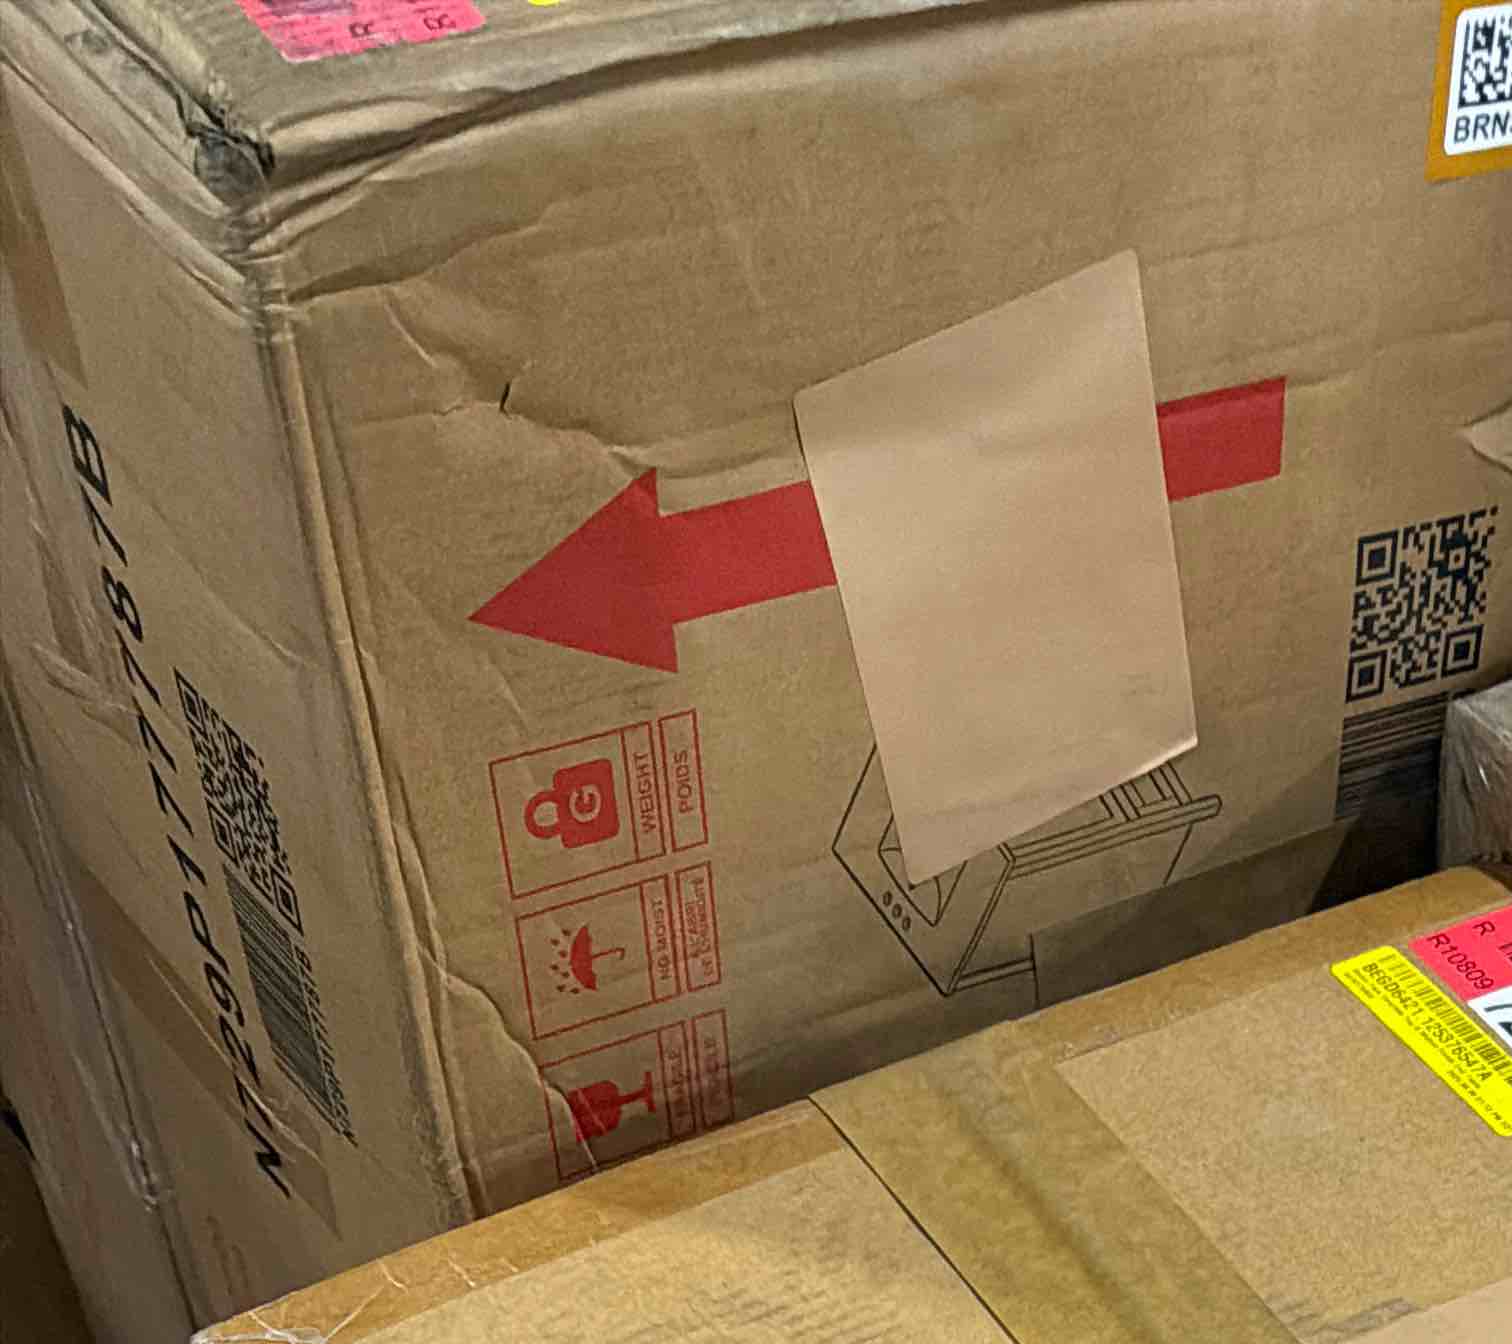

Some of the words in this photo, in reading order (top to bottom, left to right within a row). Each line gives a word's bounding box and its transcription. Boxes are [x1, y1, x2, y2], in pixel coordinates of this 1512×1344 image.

[631, 750, 655, 835] WEIGHT
[672, 748, 693, 815] POIDS
[1473, 921, 1496, 937] R
[1427, 933, 1495, 990] R10809
